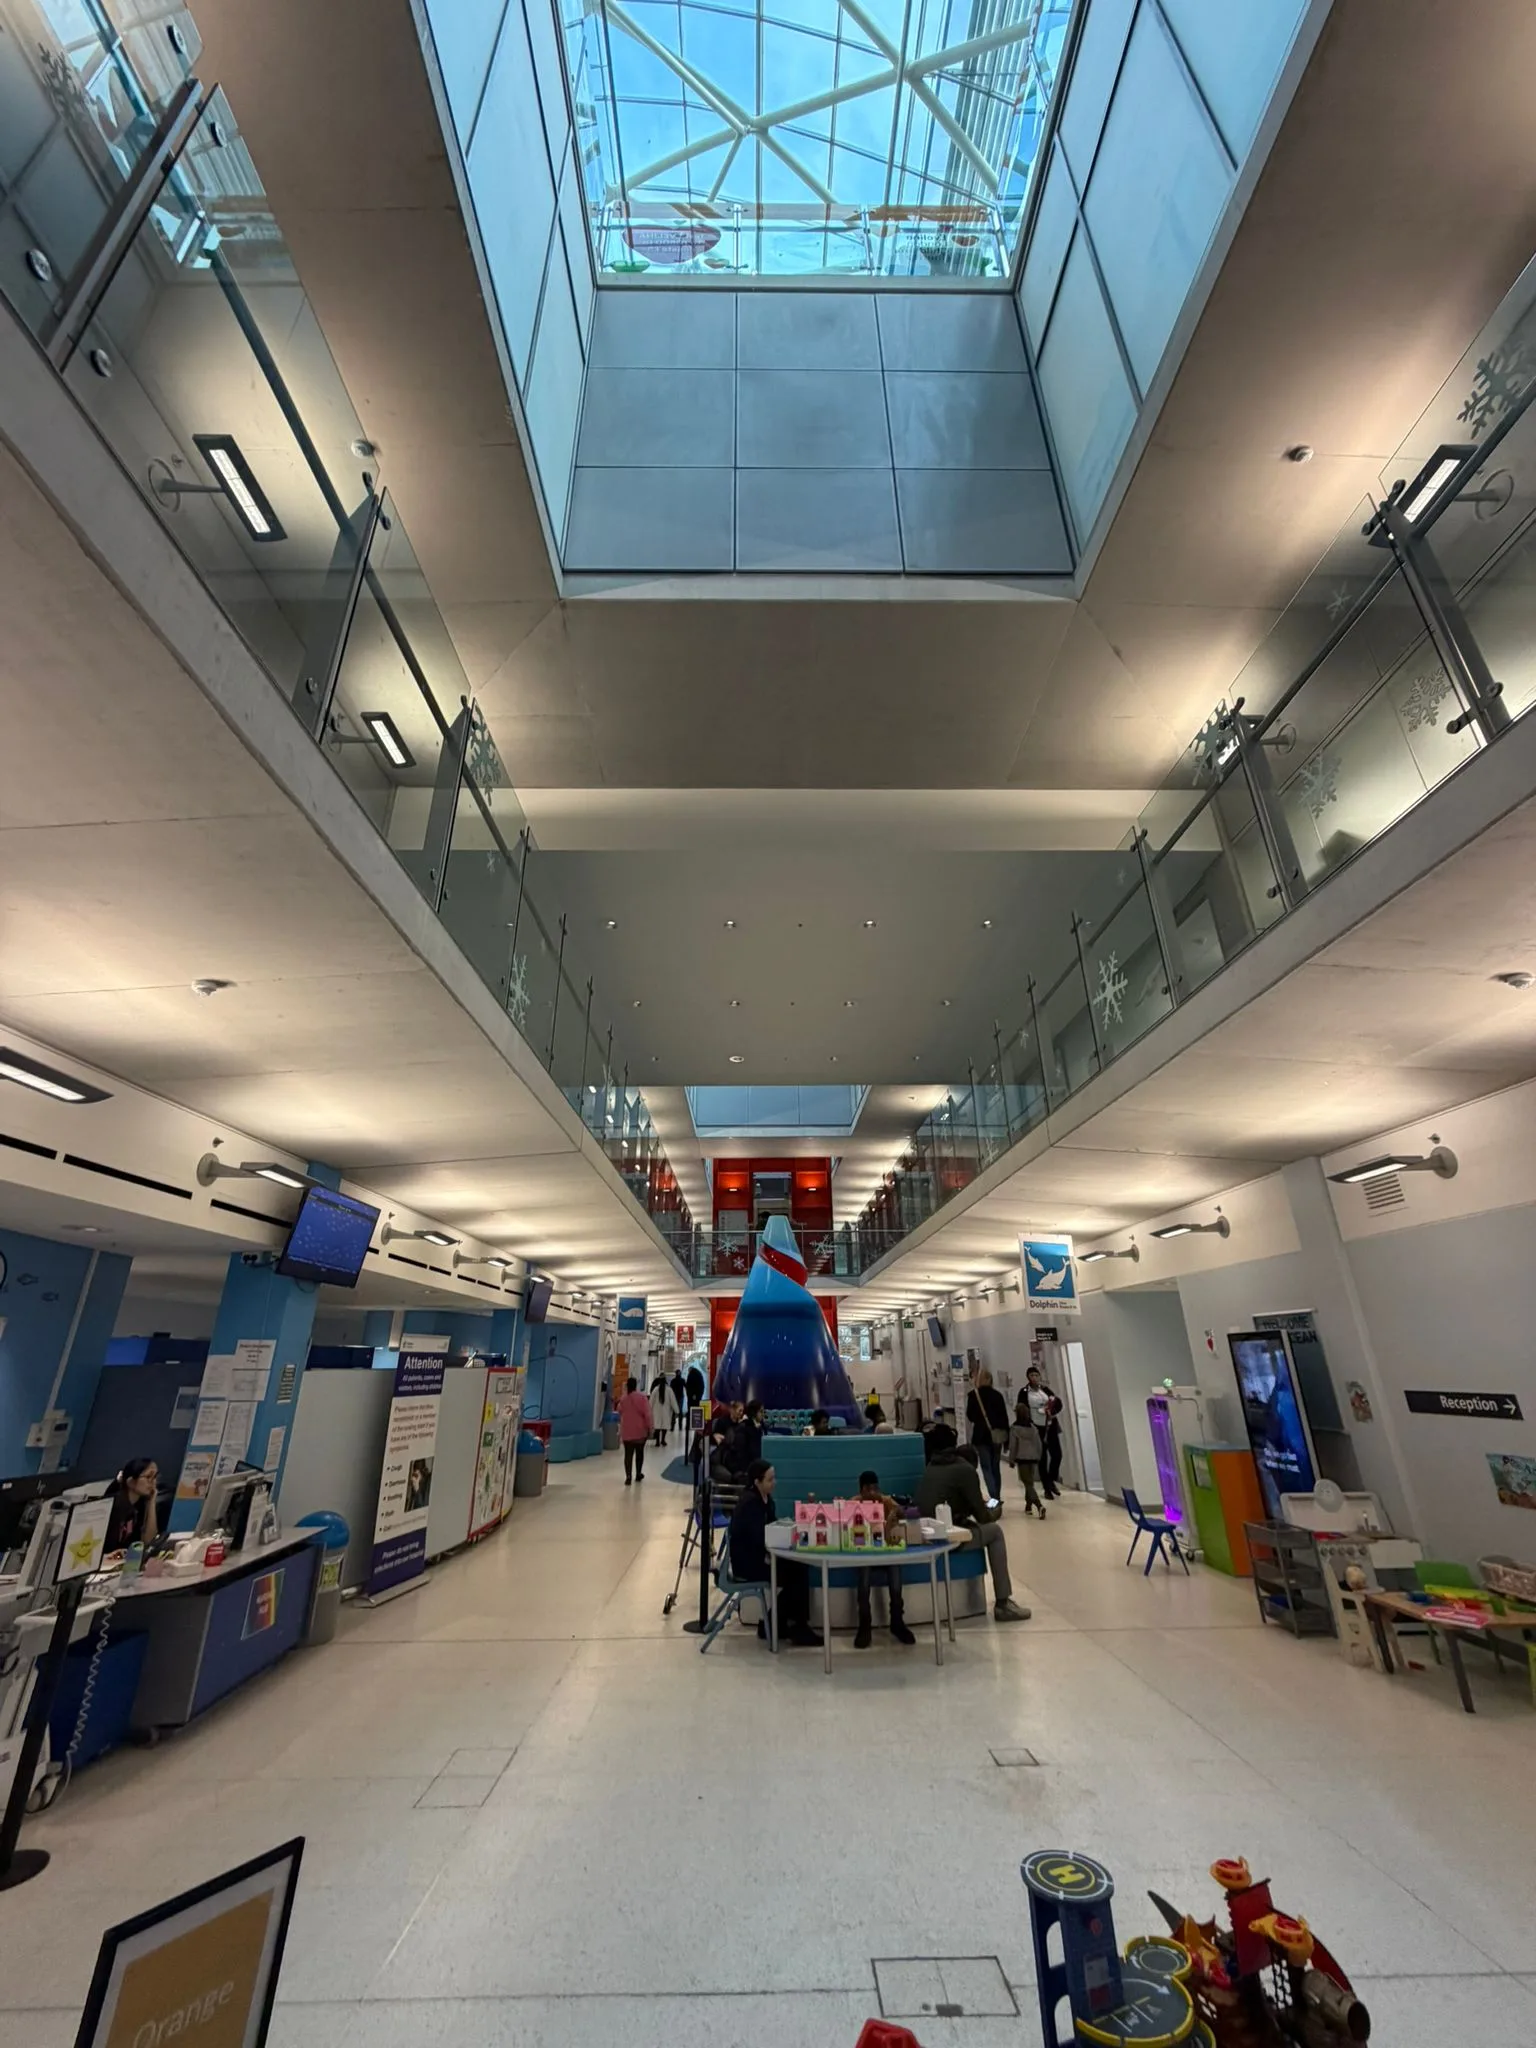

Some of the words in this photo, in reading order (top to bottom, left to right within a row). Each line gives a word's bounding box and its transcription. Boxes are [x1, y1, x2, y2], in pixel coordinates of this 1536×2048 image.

[1029, 1300, 1059, 1310] Dolphin
[404, 1356, 442, 1370] Attention
[1440, 1395, 1498, 1413] Reception
[133, 1980, 234, 2048] Orange
